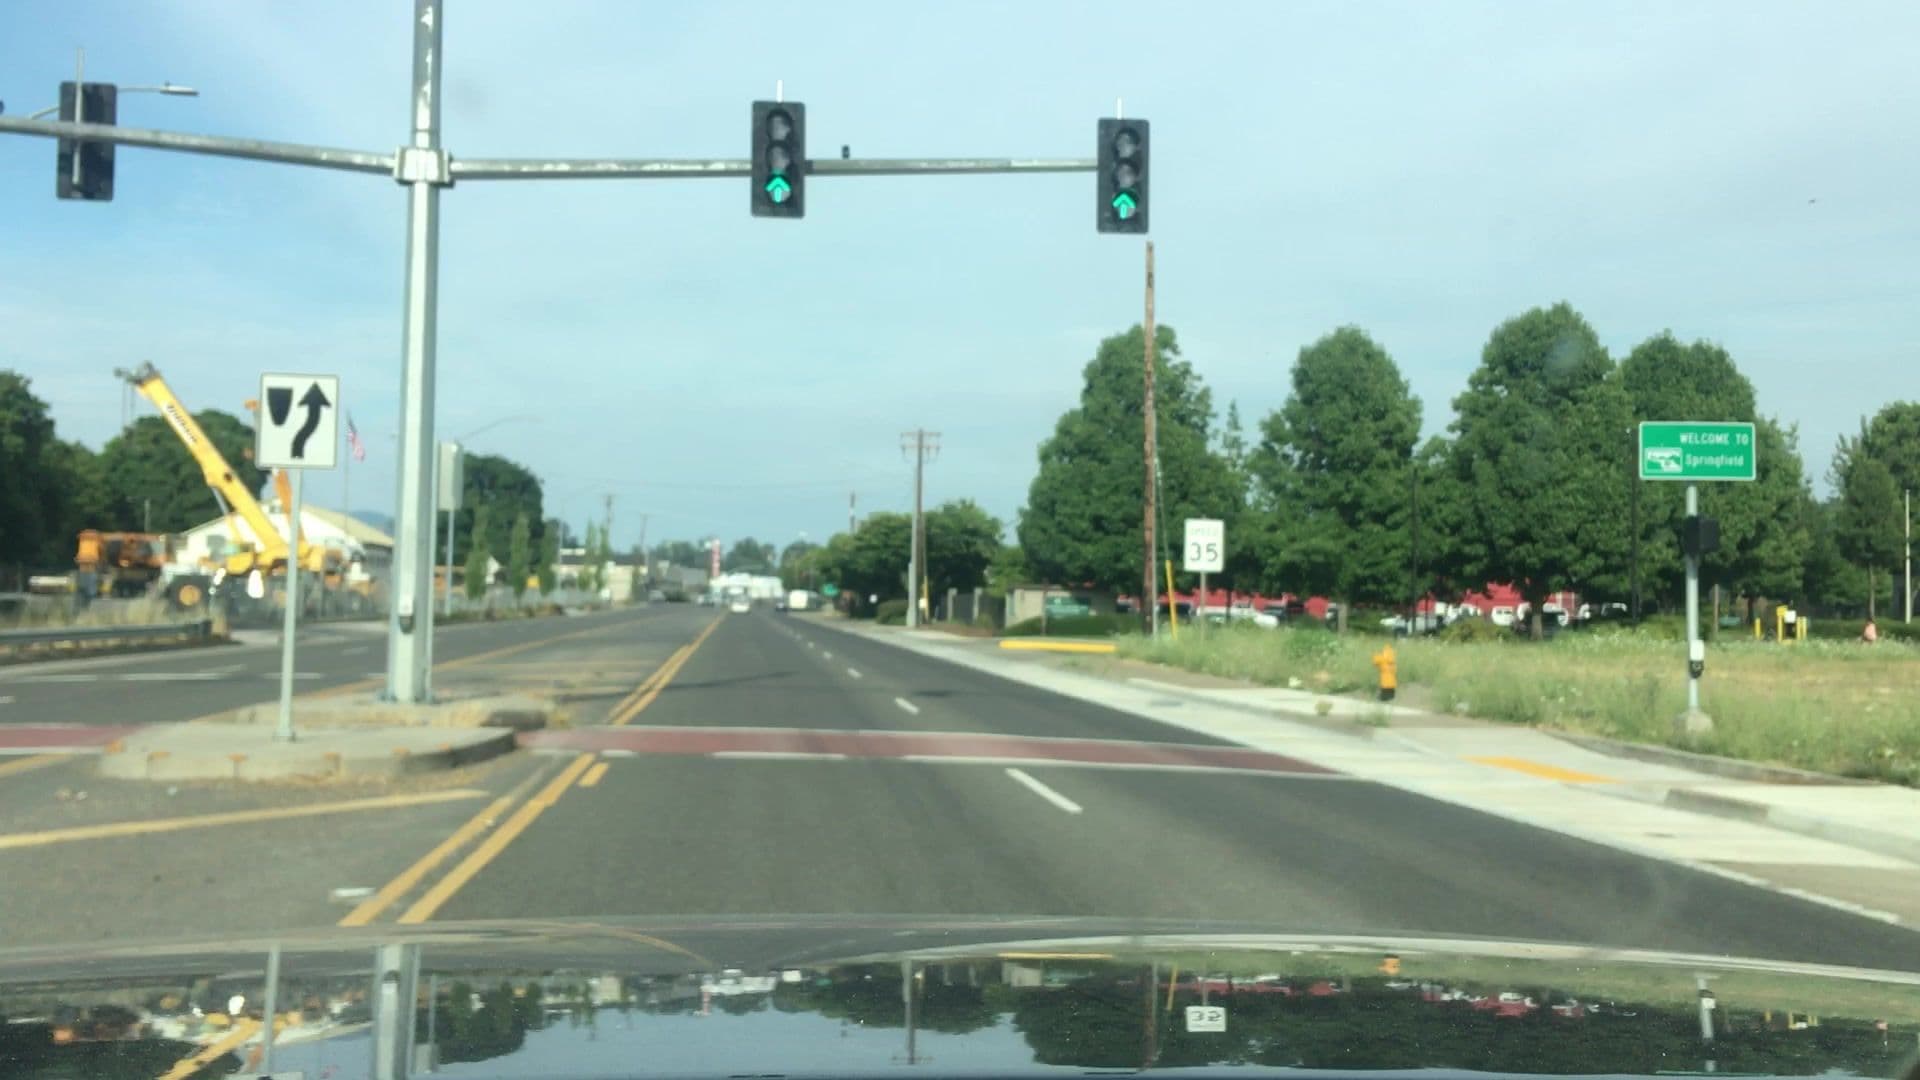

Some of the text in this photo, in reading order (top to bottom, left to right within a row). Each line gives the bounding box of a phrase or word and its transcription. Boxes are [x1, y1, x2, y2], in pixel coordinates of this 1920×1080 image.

[1680, 431, 1749, 446] WELCOME TO
[1685, 453, 1744, 468] Springfield
[1190, 542, 1218, 562] 35
